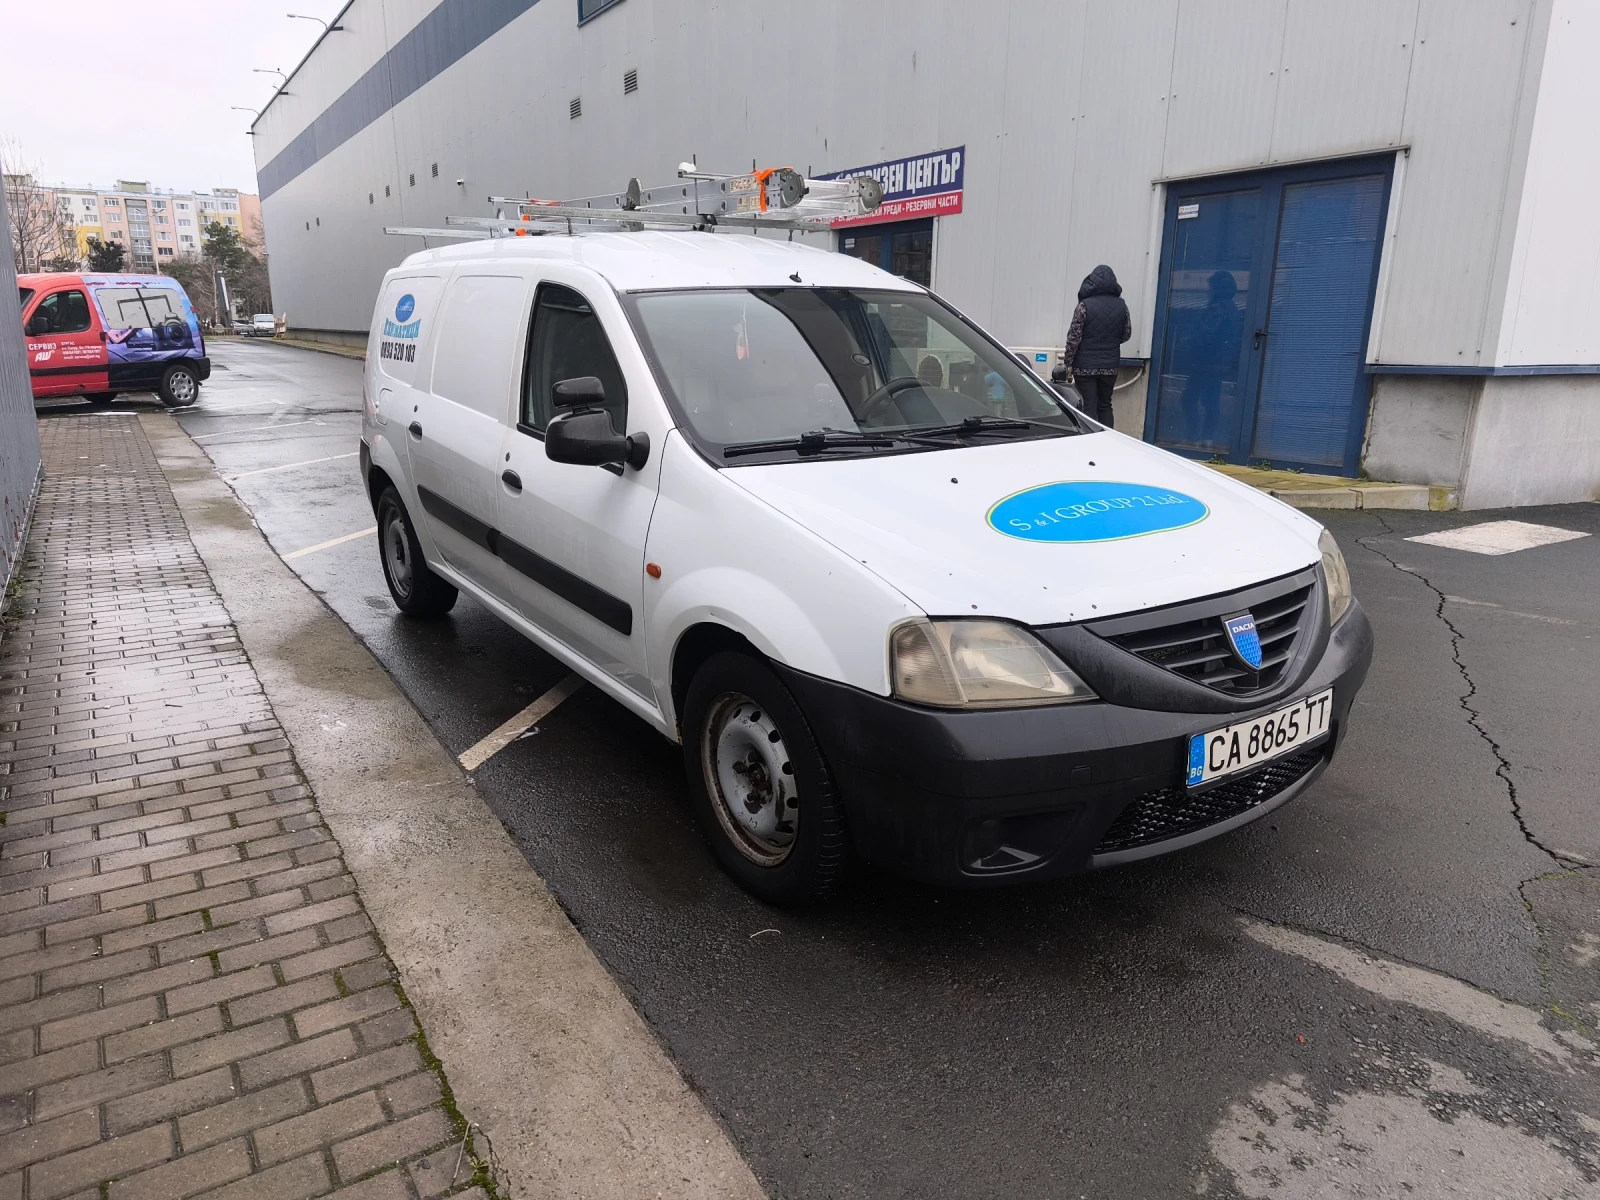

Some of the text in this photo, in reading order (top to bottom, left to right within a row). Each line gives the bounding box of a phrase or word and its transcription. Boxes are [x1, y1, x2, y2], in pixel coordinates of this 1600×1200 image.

[844, 151, 960, 195] ИЗЕН ЦЕНТЪР
[883, 203, 902, 217] УРЕДИ
[905, 199, 937, 213] РЕЗЕРВНИ
[937, 195, 959, 208] ЧАСТИ
[28, 342, 57, 351] СЕРВИЗ
[1055, 496, 1136, 519] GROUP
[1131, 496, 1154, 507] 2
[1033, 519, 1050, 527] &
[1039, 511, 1061, 523] I
[1009, 518, 1032, 531] S
[1232, 622, 1255, 633] DACIA
[1209, 695, 1329, 772] CA 8865 TT
[1190, 765, 1203, 779] BG
